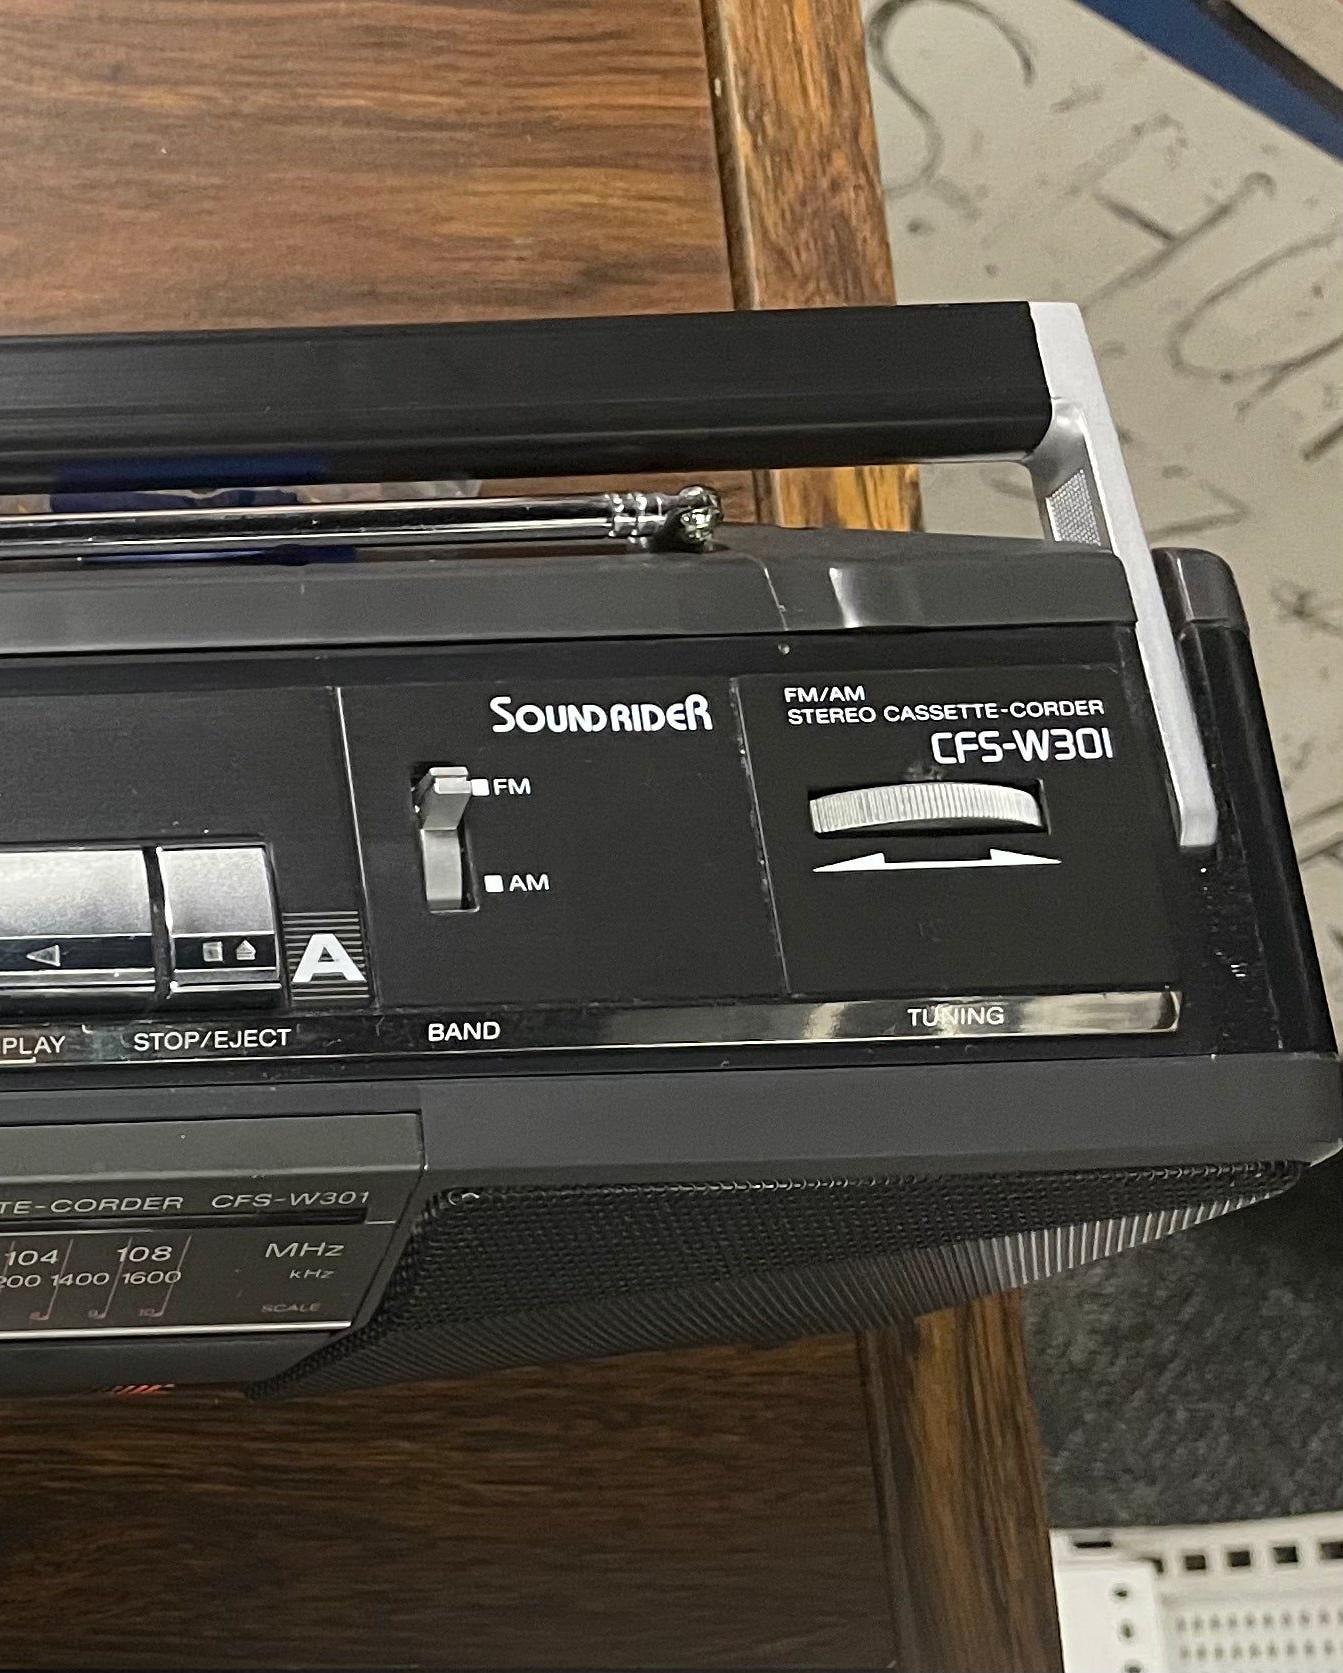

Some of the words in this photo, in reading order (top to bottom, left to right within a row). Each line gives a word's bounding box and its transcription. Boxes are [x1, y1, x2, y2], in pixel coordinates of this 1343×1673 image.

[783, 685, 866, 703] FM/AM
[787, 706, 877, 725] STEREO
[882, 700, 1106, 722] CASSETTE-CORDER
[930, 727, 1114, 765] CFS-W301
[492, 777, 532, 796] FM
[508, 873, 550, 892] AM
[291, 932, 366, 984] A
[907, 1006, 1006, 1028] TUNING
[133, 1027, 293, 1053] STOP/EJECT
[427, 1021, 501, 1043] BAND
[1, 1035, 67, 1056] PLAY
[210, 1189, 371, 1211] CFS-W301
[4, 1248, 60, 1267] 104
[116, 1245, 174, 1263] 108
[264, 1241, 346, 1258] MHz
[50, 1271, 111, 1287] 1400
[121, 1269, 182, 1285] 1600
[261, 1301, 322, 1313] SCALE
